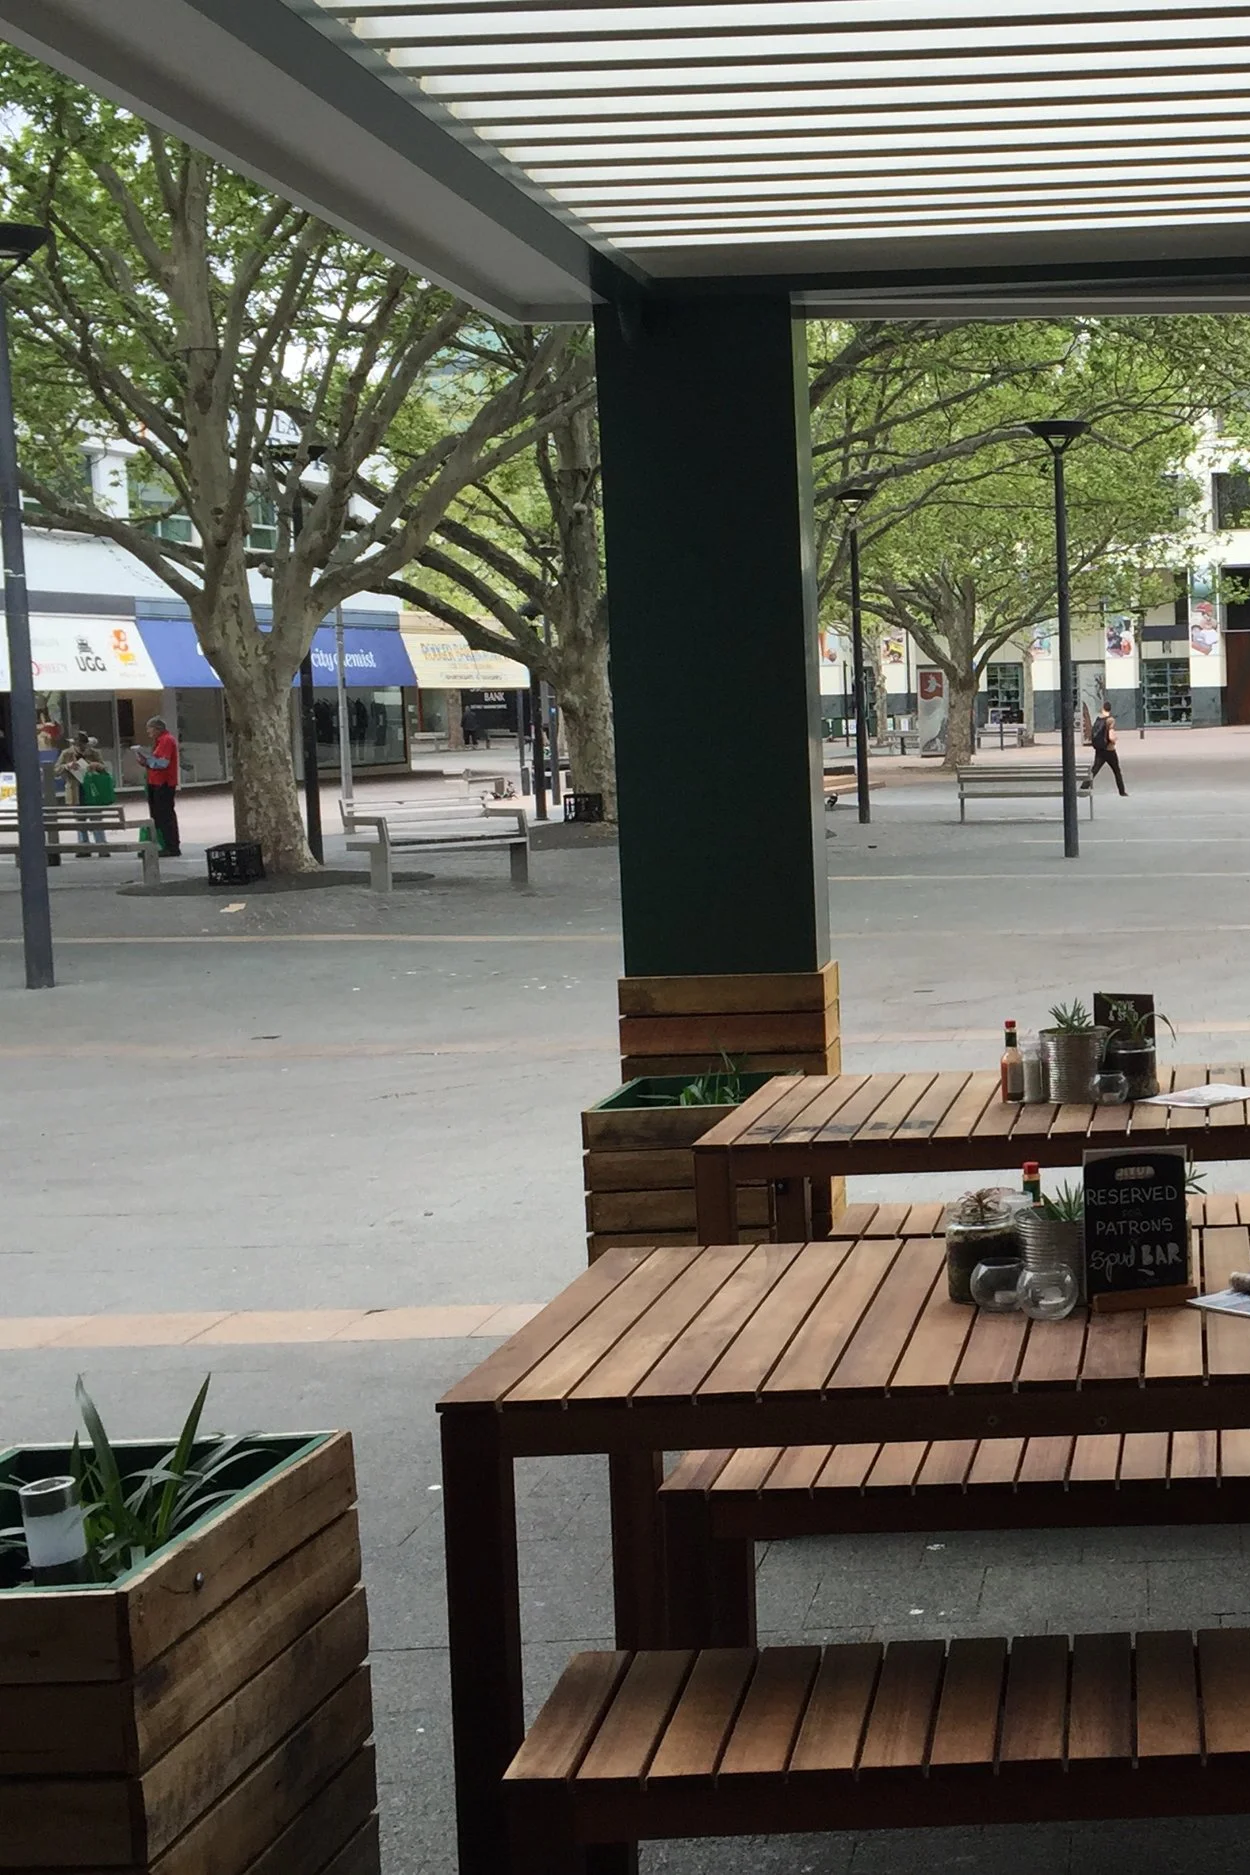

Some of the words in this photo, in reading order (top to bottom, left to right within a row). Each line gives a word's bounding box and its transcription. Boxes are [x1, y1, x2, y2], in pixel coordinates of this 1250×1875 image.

[75, 655, 107, 672] UGG
[311, 648, 333, 672] city
[334, 649, 376, 668] cemist
[484, 692, 505, 702] BANK
[1086, 1185, 1178, 1206] RESERVED
[1096, 1217, 1173, 1236] PATRONS
[1089, 1245, 1136, 1283] Spud
[1140, 1242, 1183, 1266] BAR
